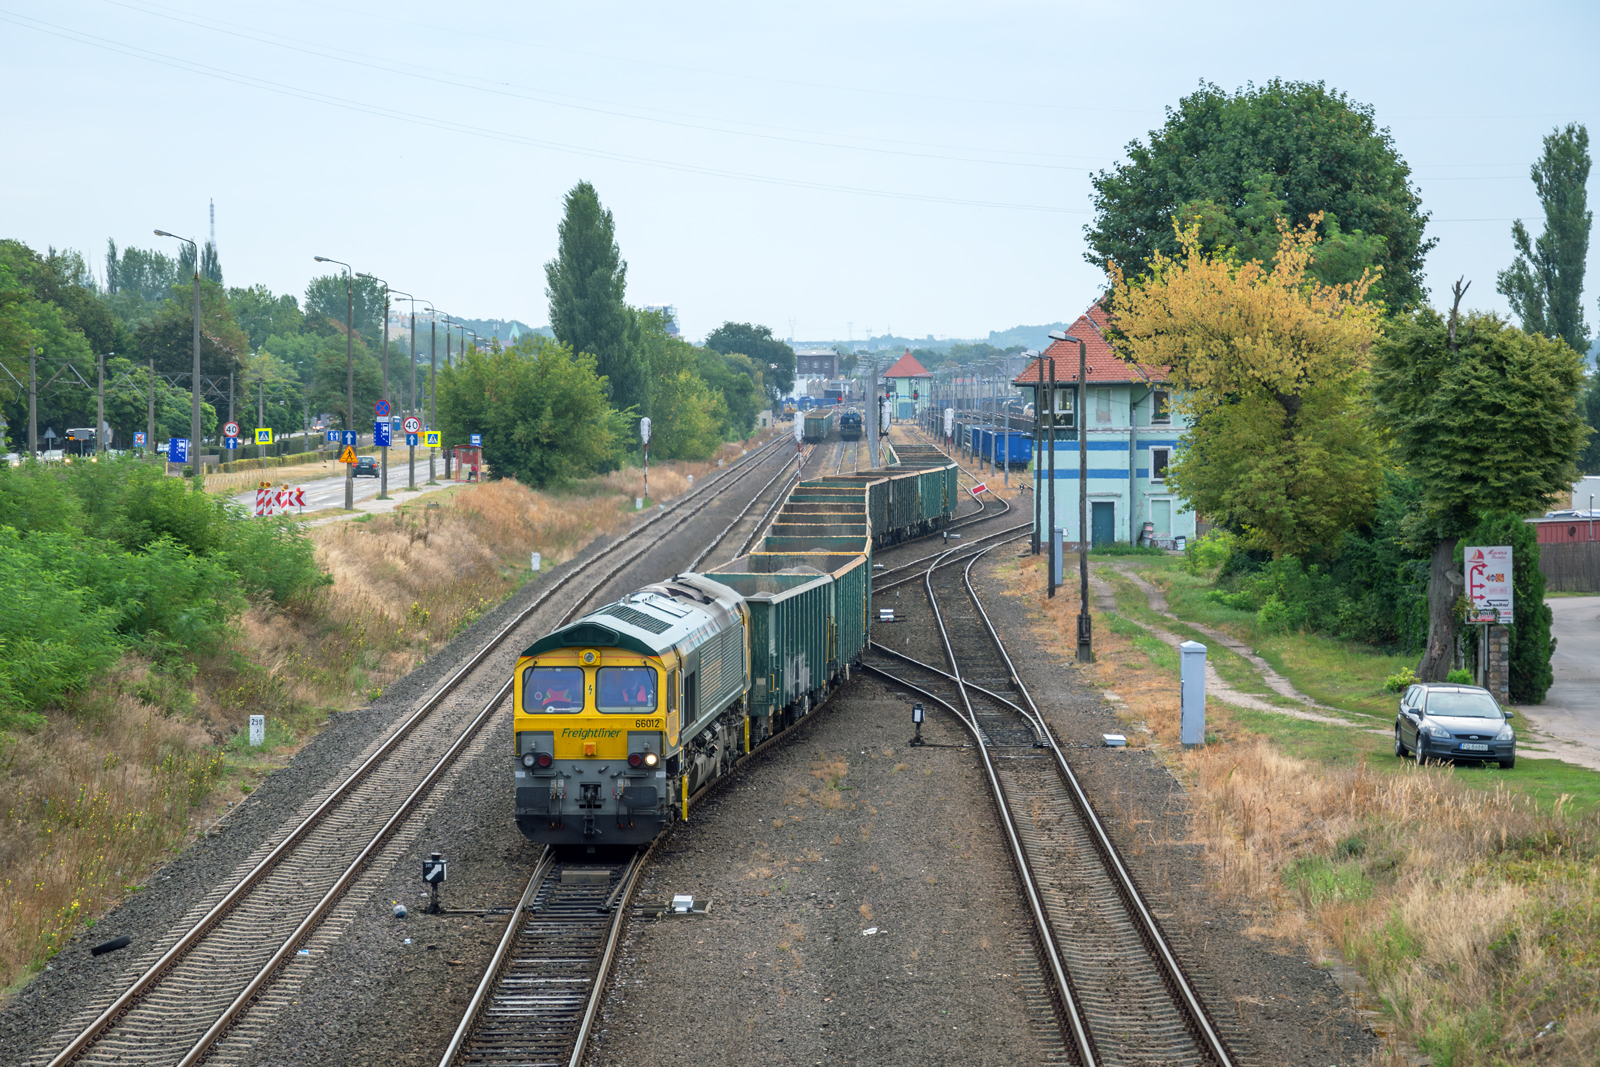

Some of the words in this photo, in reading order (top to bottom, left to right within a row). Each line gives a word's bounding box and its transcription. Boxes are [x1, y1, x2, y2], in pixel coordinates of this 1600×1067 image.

[405, 421, 418, 430] 40
[635, 719, 660, 728] 66012
[561, 727, 622, 740] Freightliner
